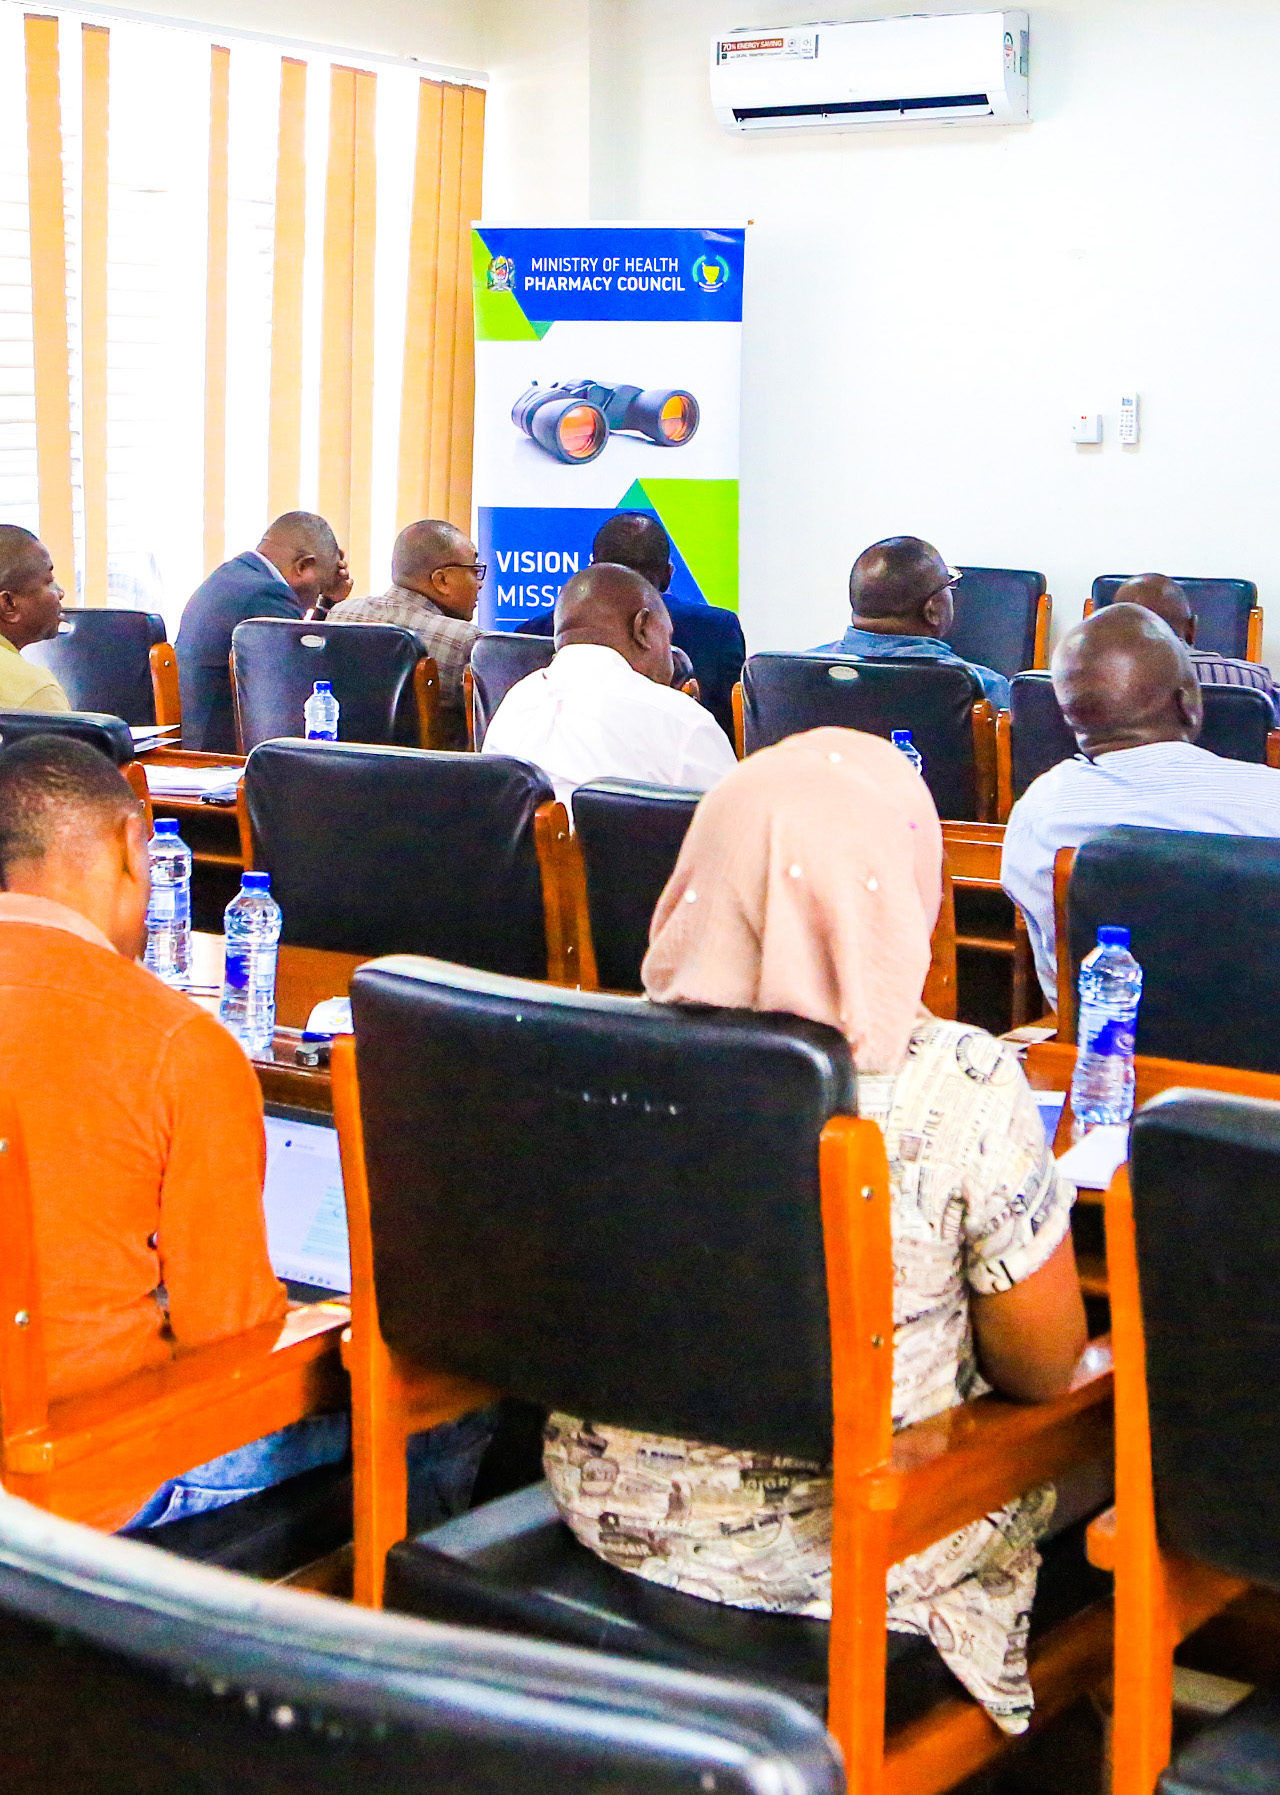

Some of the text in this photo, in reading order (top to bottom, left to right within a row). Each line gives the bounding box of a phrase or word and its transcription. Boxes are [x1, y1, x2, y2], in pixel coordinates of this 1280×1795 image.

[737, 42, 759, 50] ENERGY
[760, 40, 782, 48] SAVING
[531, 257, 678, 272] MINISTRY OF HEALTH
[524, 276, 685, 291] PHARMACY COUNCIL
[496, 551, 579, 573] VISION
[497, 585, 561, 607] MISS
